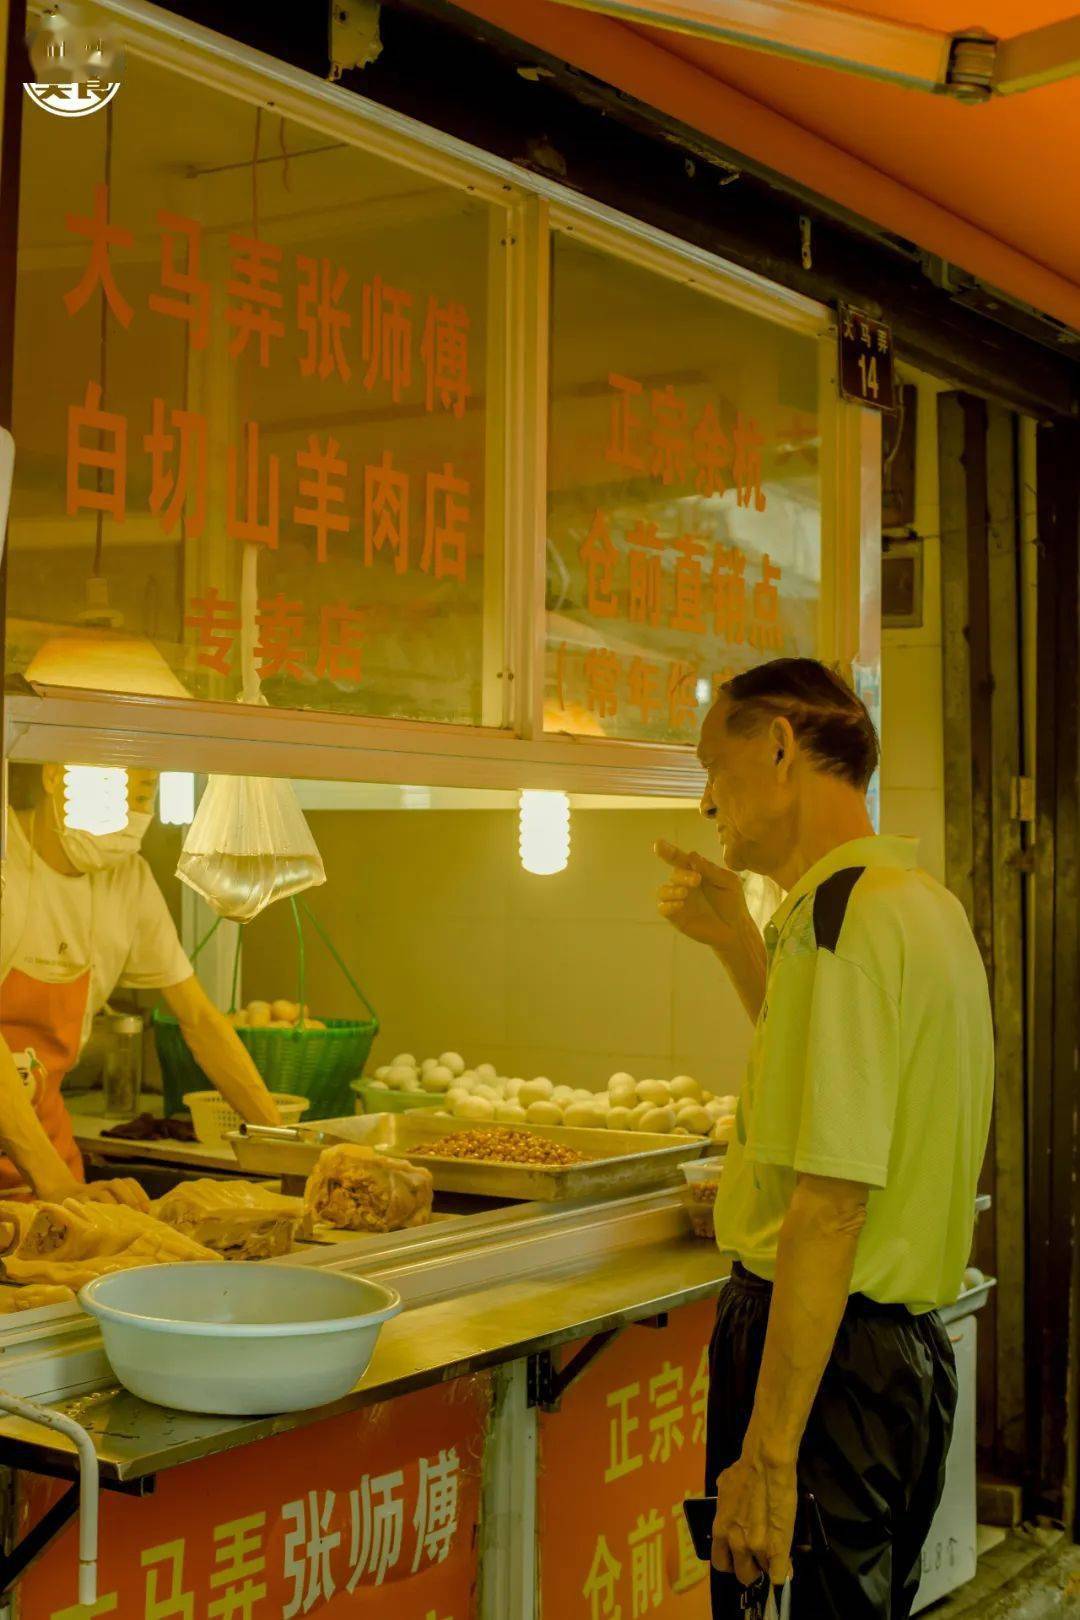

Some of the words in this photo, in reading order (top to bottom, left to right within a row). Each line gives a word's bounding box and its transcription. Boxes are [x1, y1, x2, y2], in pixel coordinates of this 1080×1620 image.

[63, 184, 472, 420] 大马弄张师傅
[605, 371, 767, 513] 正宗余杭
[858, 354, 879, 399] 14
[65, 380, 471, 583] 白切山羊肉店
[184, 587, 364, 684] 专卖店
[579, 507, 785, 655] 仓前直销点
